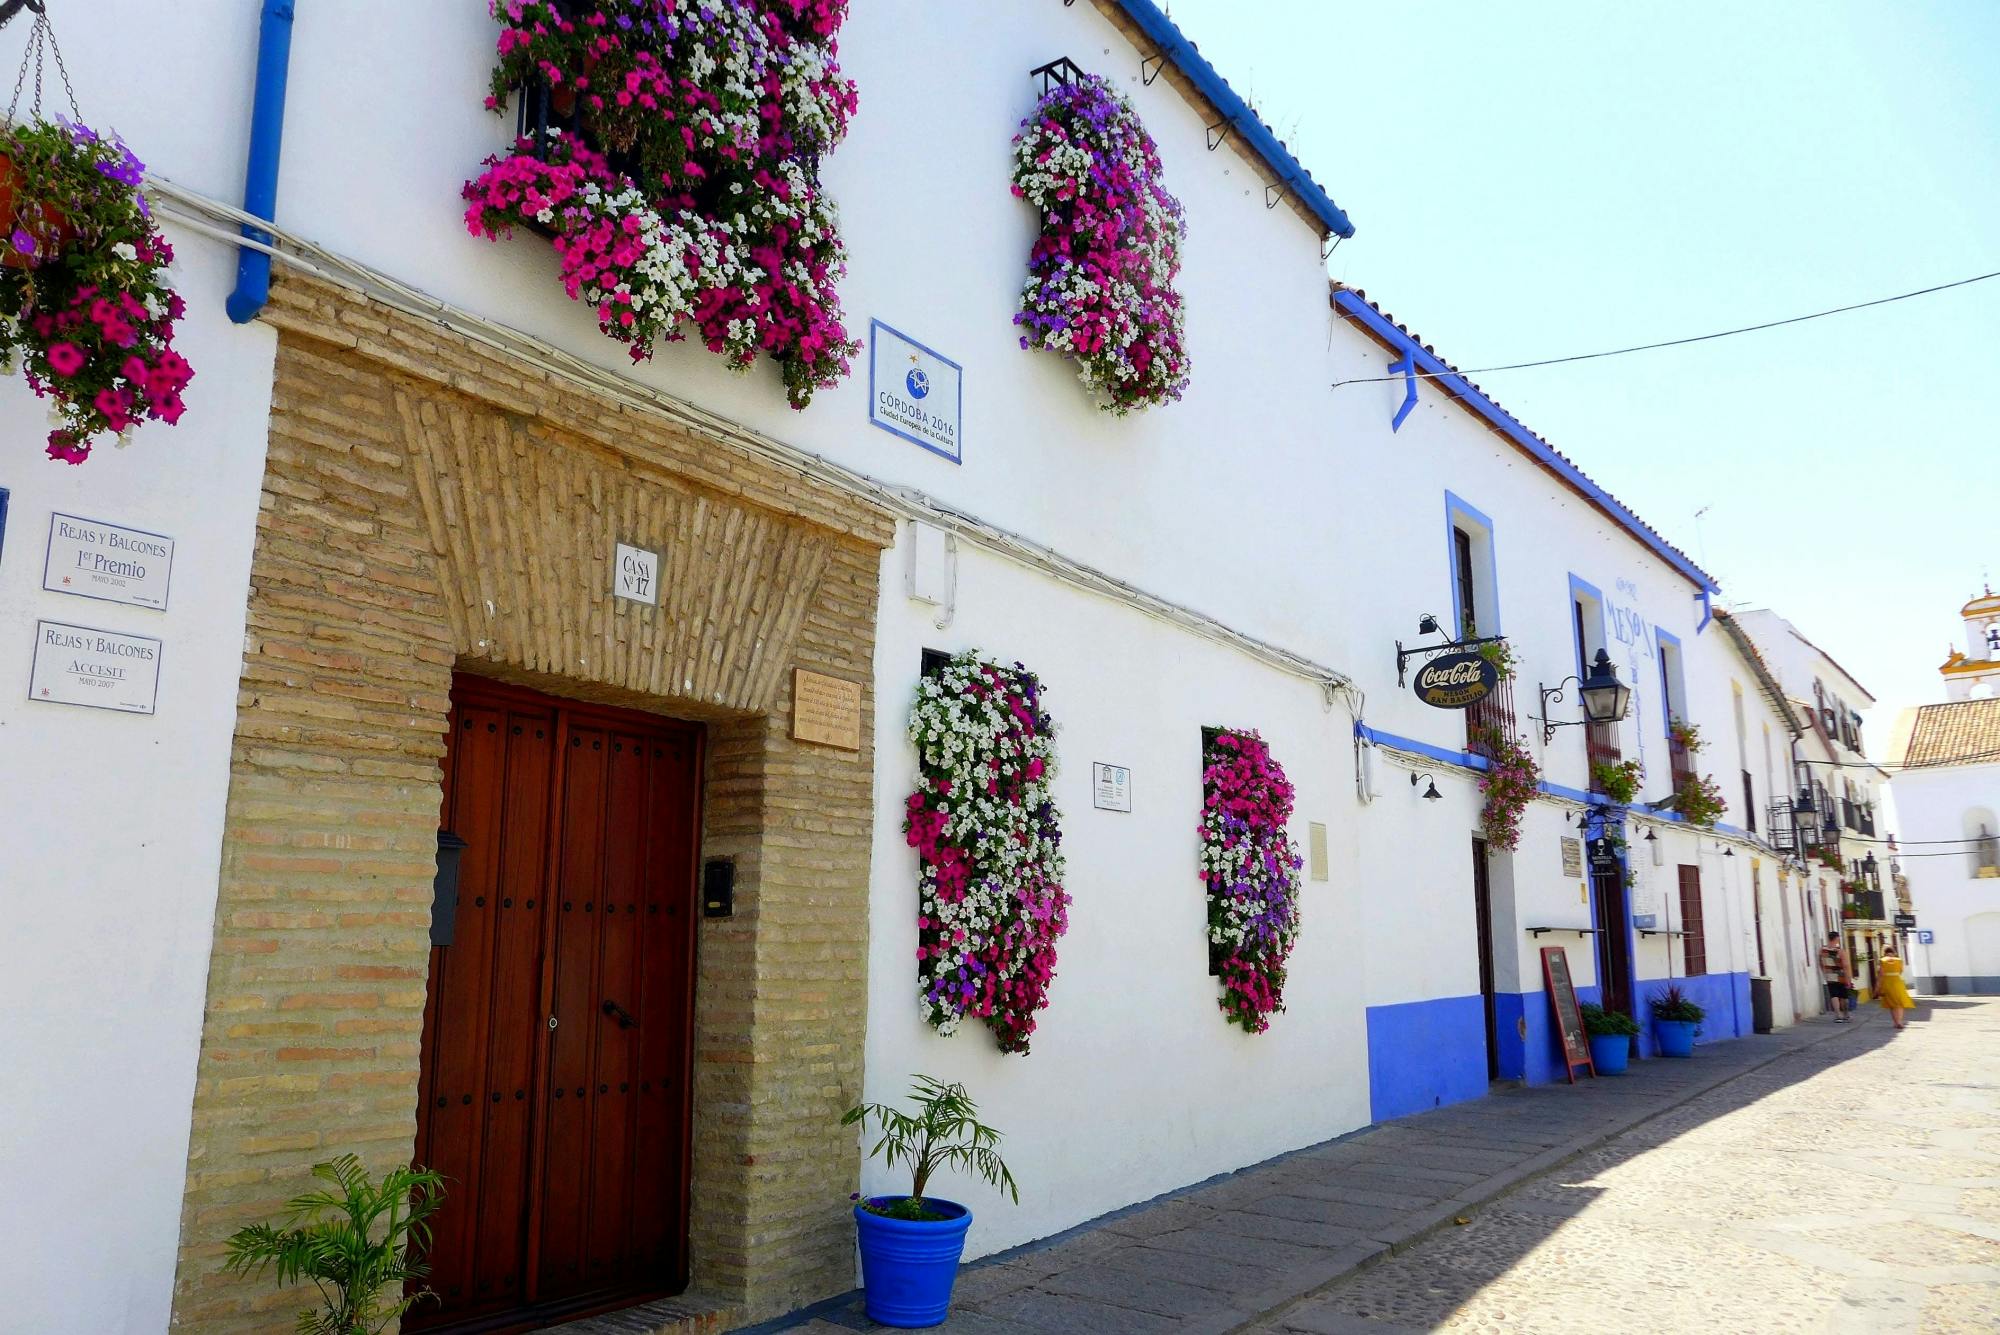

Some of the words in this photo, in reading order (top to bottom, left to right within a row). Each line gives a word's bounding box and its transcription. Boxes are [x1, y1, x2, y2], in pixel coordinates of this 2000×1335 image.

[880, 391, 929, 424] CÓRDOBA
[932, 416, 954, 436] 2016
[879, 406, 899, 421] Ciudad
[899, 415, 921, 432] Europea
[922, 426, 929, 435] de
[929, 429, 935, 438] la
[935, 432, 954, 447] Cultura
[94, 554, 147, 579] Premio
[623, 555, 650, 579] CASA
[91, 574, 109, 585] MAYO
[79, 677, 96, 687] MAYO
[97, 679, 115, 689] 2007
[1421, 660, 1482, 689] Coca-Cola
[1431, 696, 1448, 704] SAN
[1450, 690, 1483, 704] BASILIO
[1920, 932, 1930, 942] P
